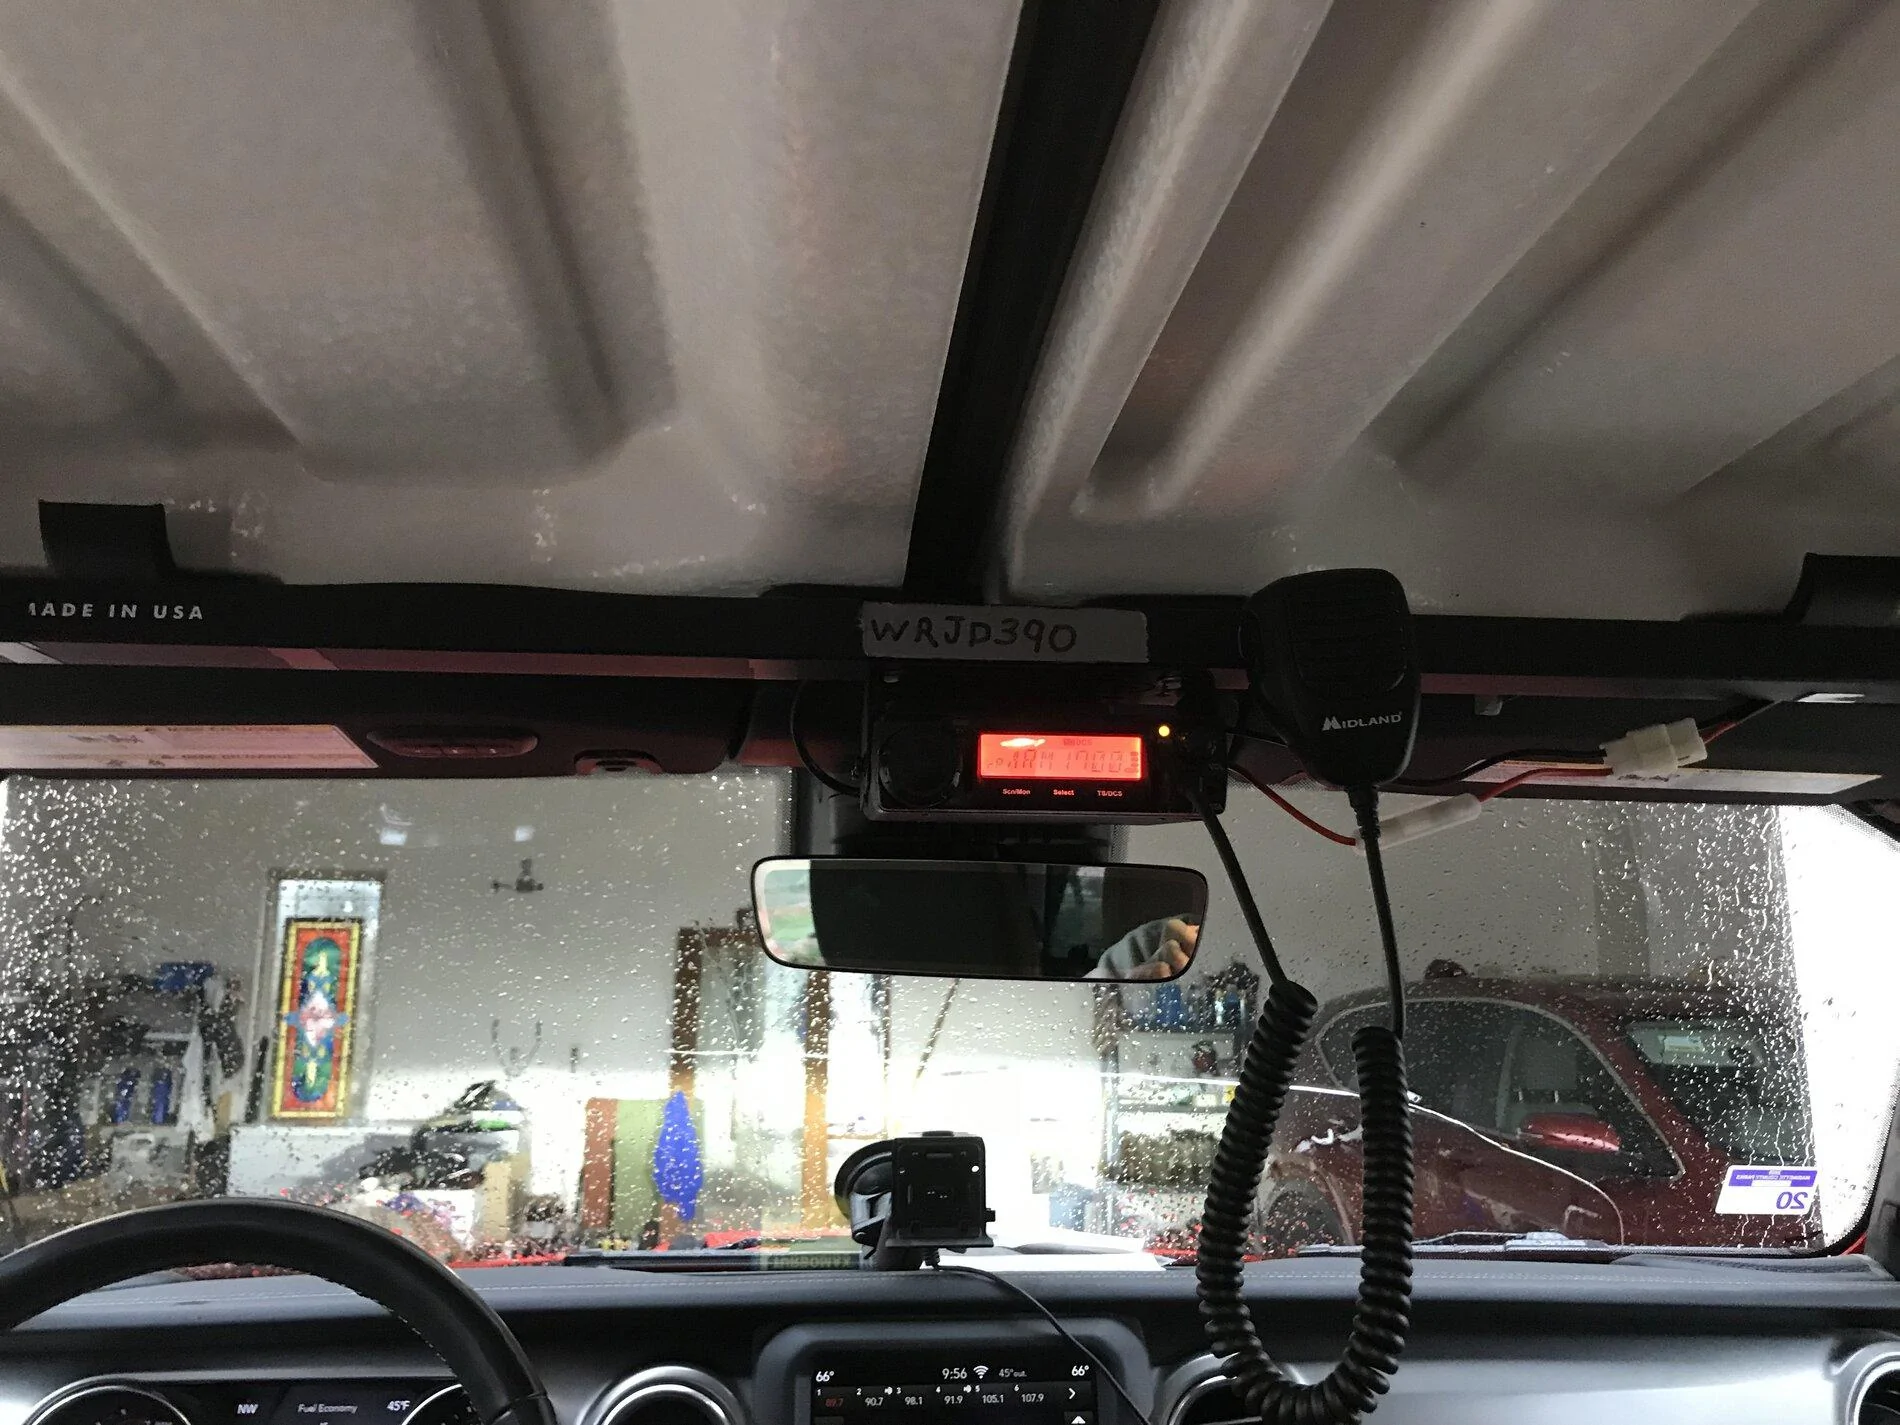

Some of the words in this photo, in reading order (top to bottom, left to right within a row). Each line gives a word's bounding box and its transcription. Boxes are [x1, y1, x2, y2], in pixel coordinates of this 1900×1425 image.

[109, 604, 137, 618] IN
[153, 606, 203, 620] USA
[871, 614, 1078, 654] WRJD390
[1322, 714, 1402, 731] MIDLAND
[1053, 788, 1075, 797] Select
[942, 1367, 968, 1380] 9:56
[1071, 1365, 1090, 1377] 66°
[815, 1370, 835, 1383] 66°
[856, 1388, 862, 1396] 2
[896, 1387, 902, 1395] 3
[935, 1386, 941, 1394] 4
[975, 1385, 981, 1393] 5
[1014, 1384, 1020, 1392] 6
[864, 1397, 884, 1408] 90.7
[904, 1396, 923, 1406] 98.1
[944, 1395, 964, 1405] 91.9
[981, 1394, 1005, 1404] 105.1
[1021, 1393, 1045, 1403] 107.9
[237, 1403, 259, 1415] NW
[297, 1403, 318, 1414] Fuel
[318, 1404, 359, 1415] Economy
